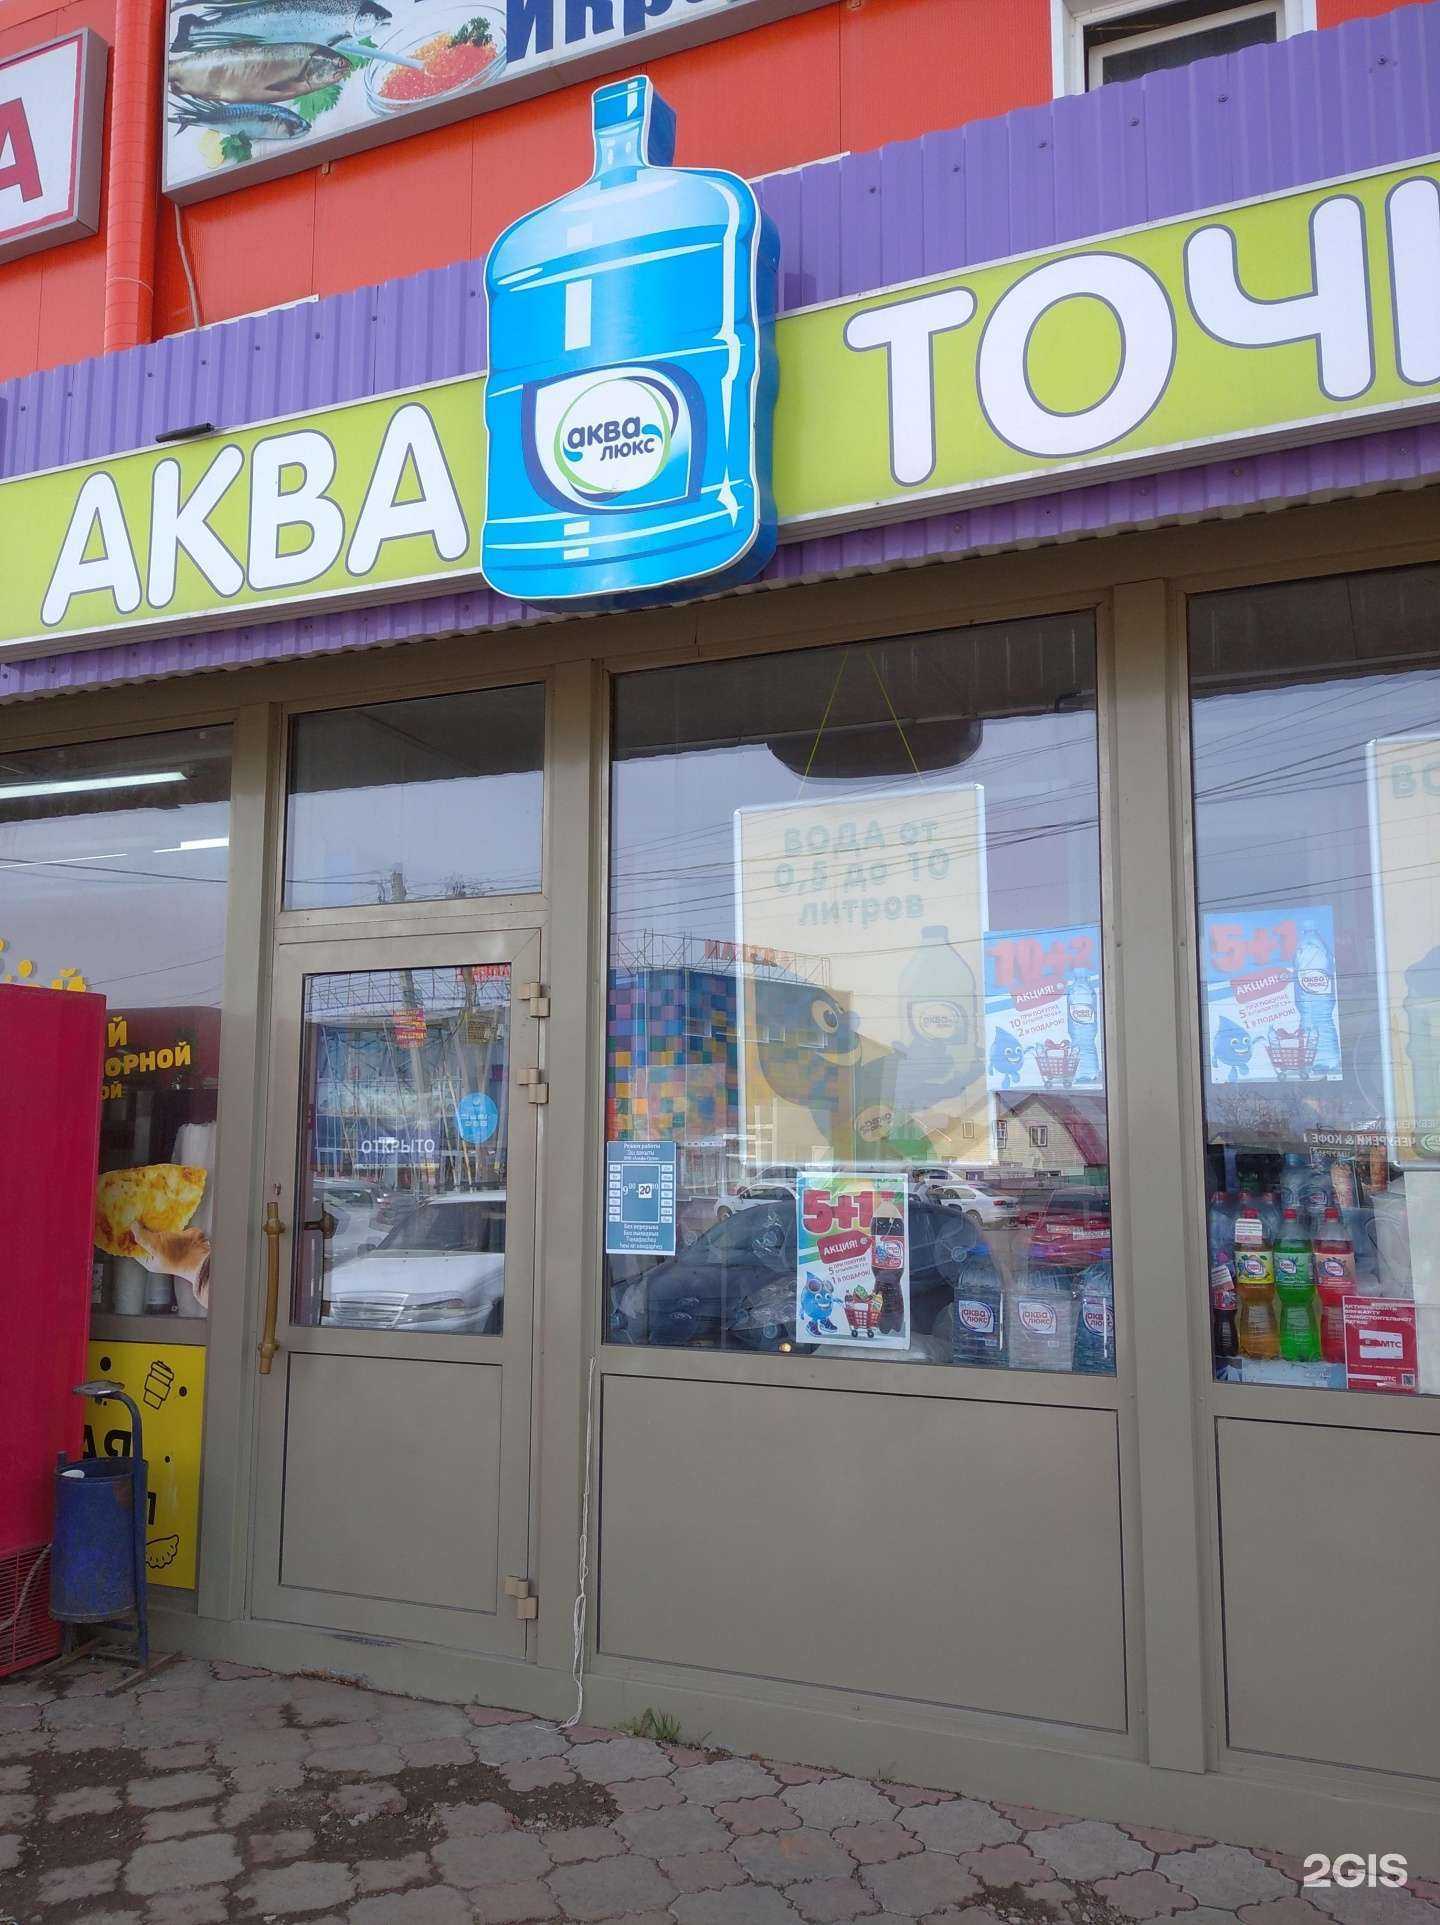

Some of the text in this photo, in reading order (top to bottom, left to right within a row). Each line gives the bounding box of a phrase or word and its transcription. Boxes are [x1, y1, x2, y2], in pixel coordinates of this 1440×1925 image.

[567, 416, 641, 449] аква
[600, 438, 655, 461] люкс
[41, 402, 469, 626] АКВА
[784, 819, 938, 859] ВОДА от
[773, 848, 951, 893] 0,5 до 10
[799, 895, 925, 929] литров
[1210, 920, 1298, 972] 5+1
[989, 935, 1093, 987] 10+2
[1016, 984, 1056, 1004] АКЦИЯ!
[1236, 975, 1280, 996] АКЦИЯ!
[361, 1138, 435, 1154] ОТКРЫТО
[803, 1189, 874, 1234] 5+1
[823, 1239, 858, 1256] АКЦИЯ!
[963, 1309, 986, 1317] аква
[1025, 1310, 1048, 1319] аква
[1090, 1319, 1113, 1328] люс
[1381, 1340, 1402, 1348] МТС
